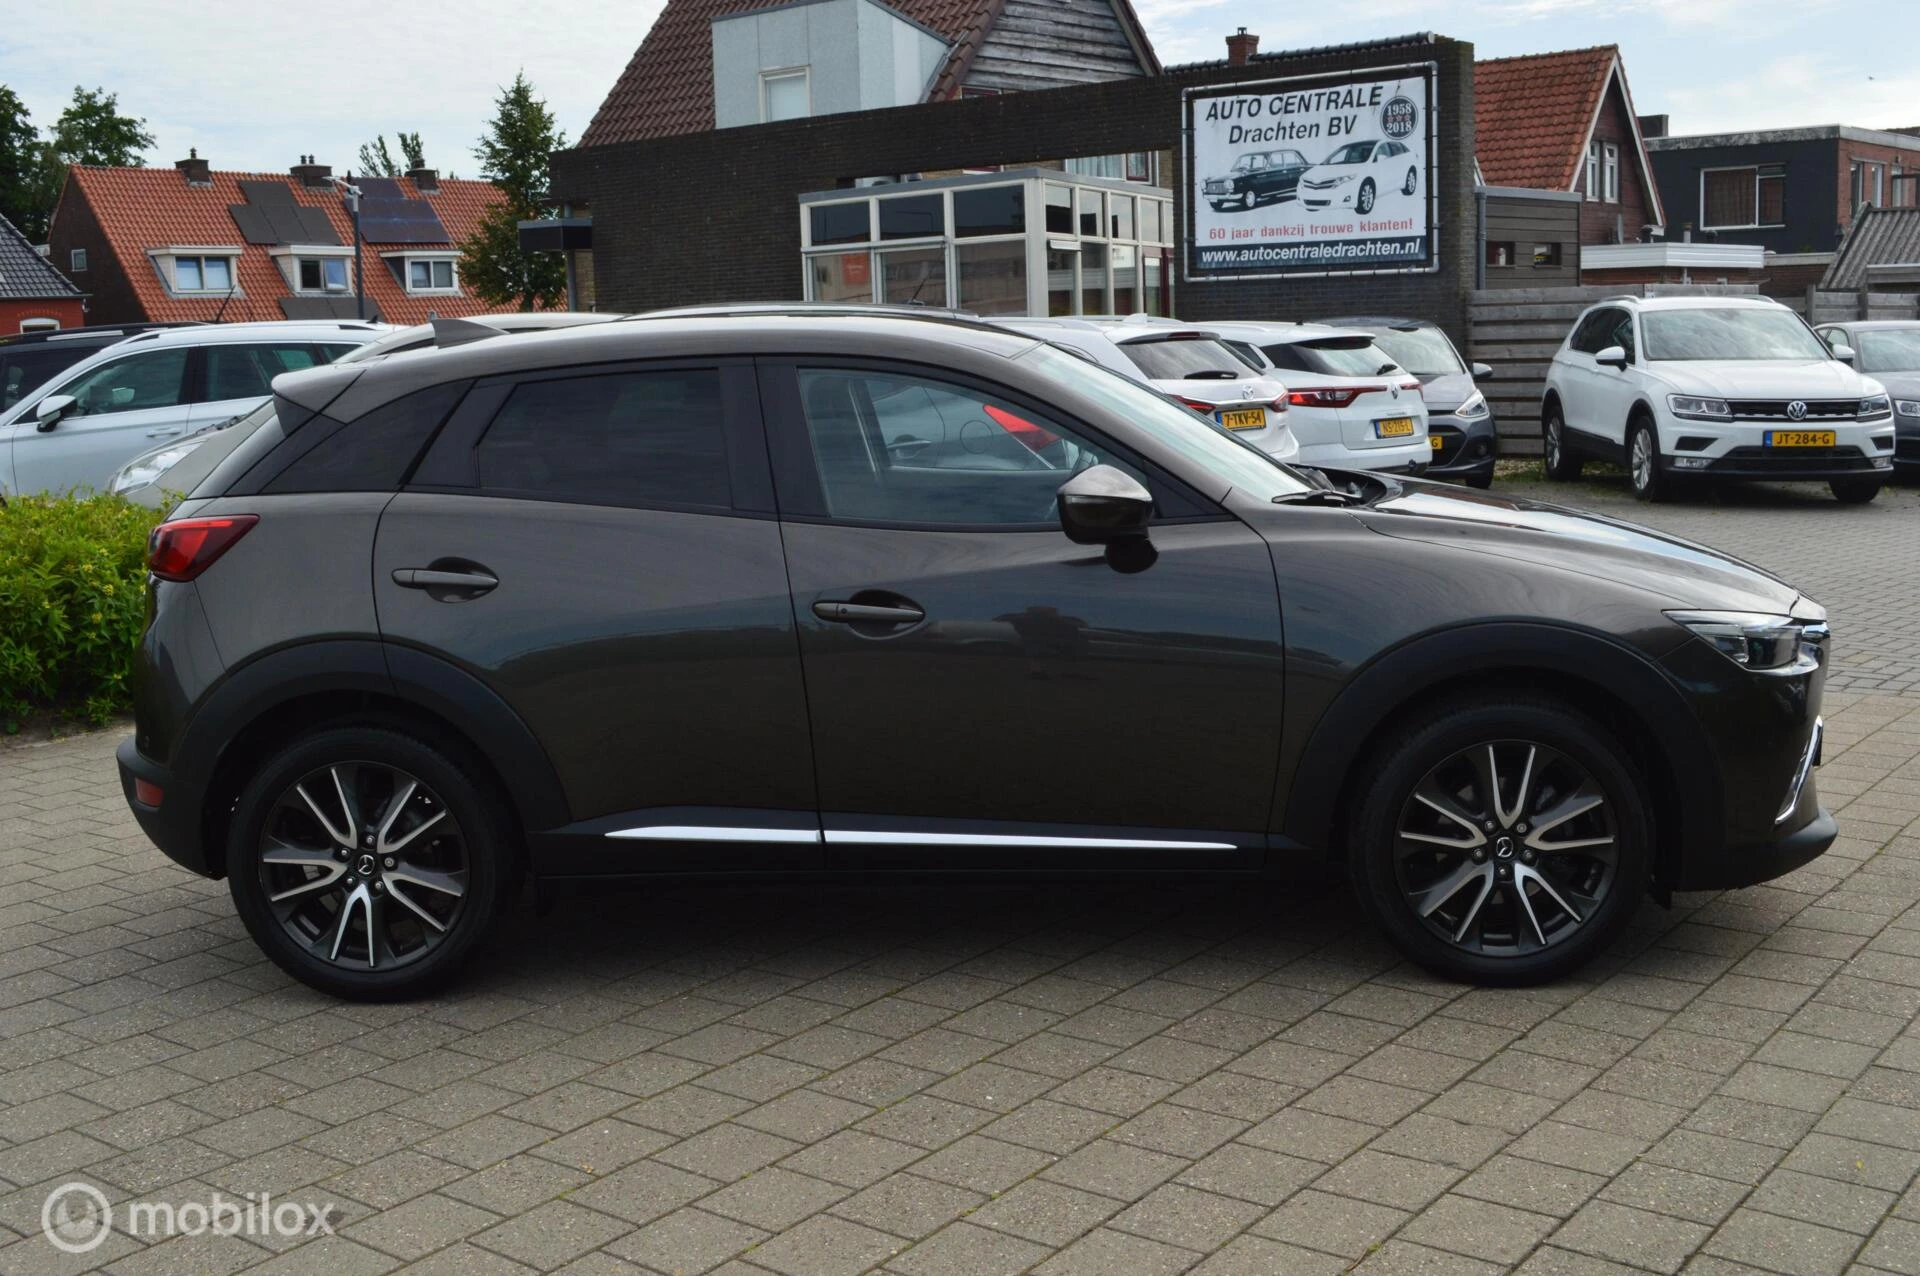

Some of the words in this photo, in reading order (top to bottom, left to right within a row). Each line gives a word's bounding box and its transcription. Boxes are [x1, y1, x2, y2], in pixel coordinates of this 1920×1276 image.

[1206, 98, 1262, 121] AUTO
[1268, 86, 1384, 116] CENTRALE
[1387, 103, 1412, 116] 1958
[1228, 121, 1320, 144] Drachten
[1327, 115, 1357, 136] BV
[1387, 121, 1412, 133] 2018
[1209, 228, 1226, 239] 60
[1231, 226, 1255, 240] jaar
[1261, 224, 1304, 237] dankzij
[1310, 223, 1354, 235] trouwe
[1360, 218, 1413, 232] klanten!
[1202, 238, 1420, 262] www.autocentraledrachten.nl
[1777, 433, 1830, 445] JT-284-G
